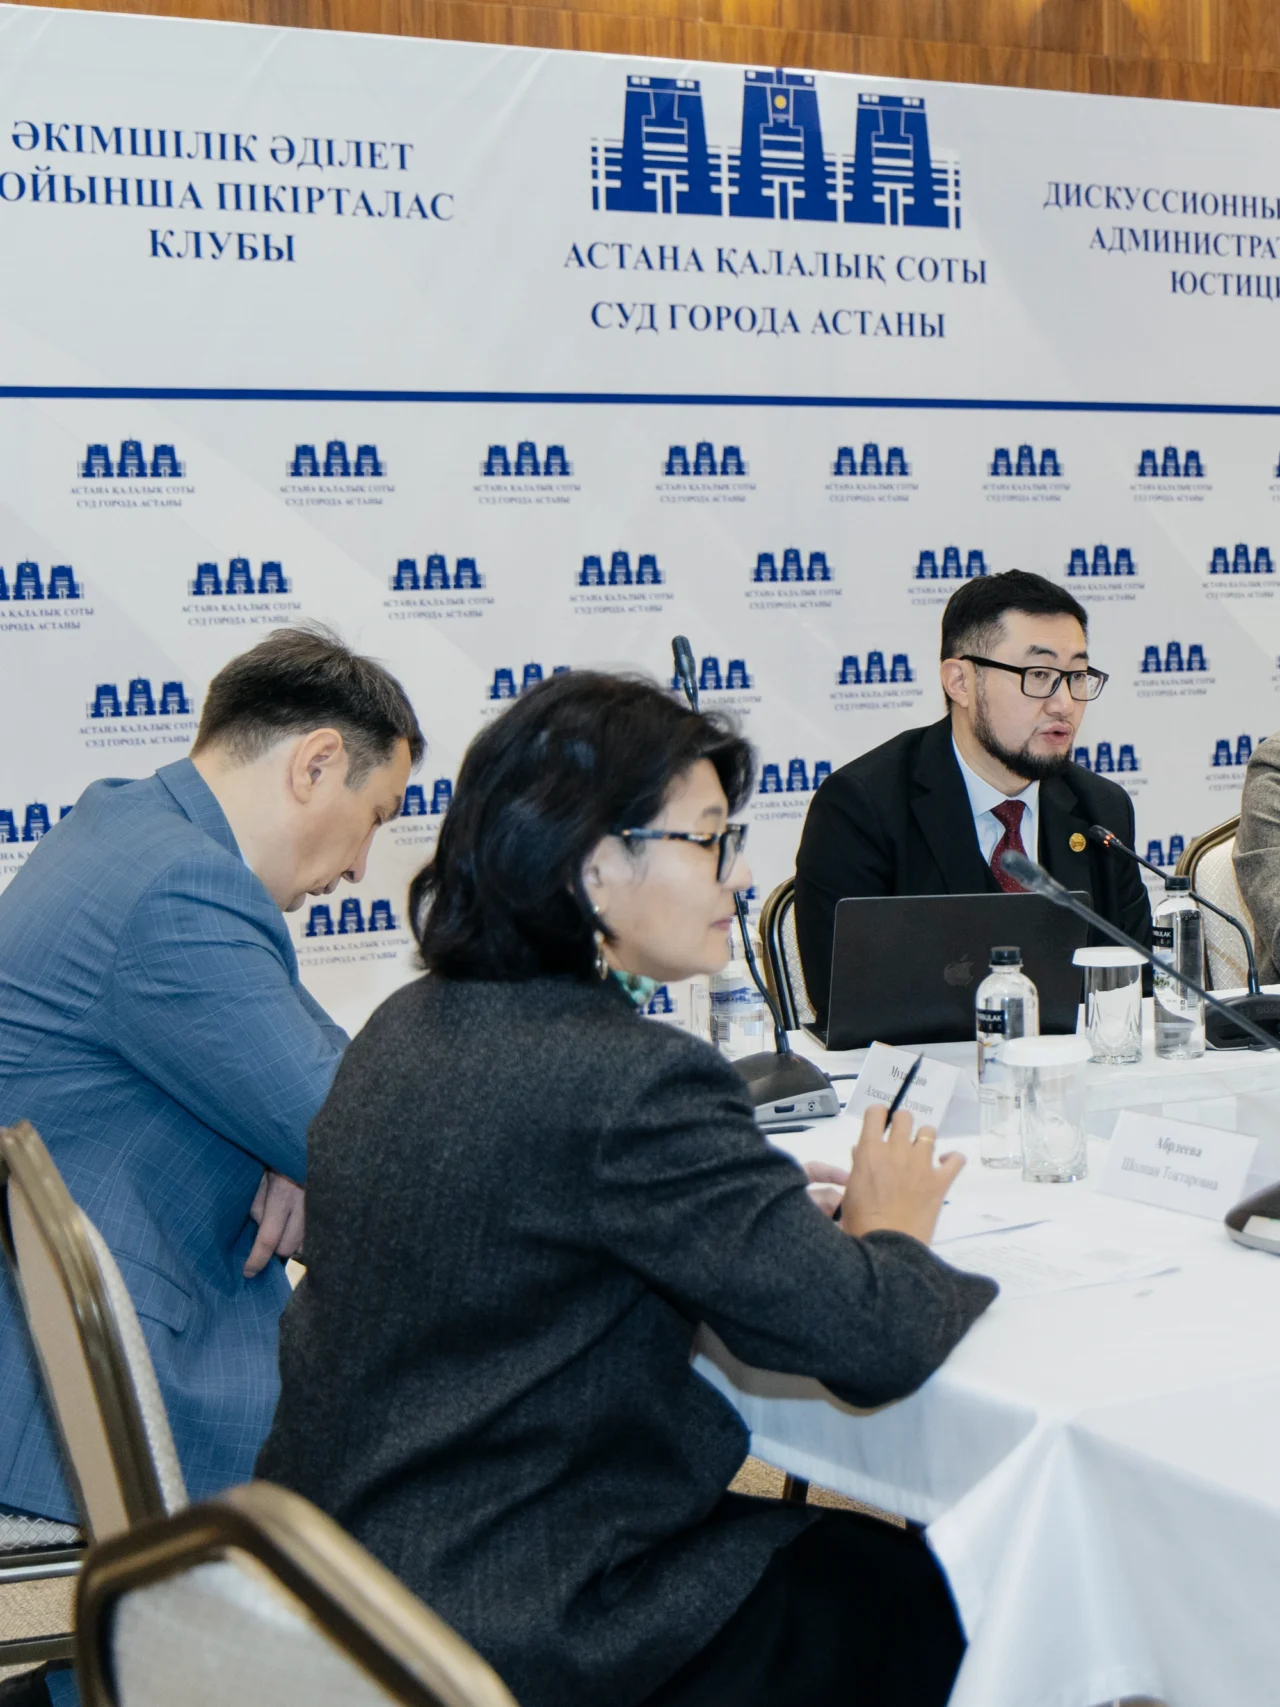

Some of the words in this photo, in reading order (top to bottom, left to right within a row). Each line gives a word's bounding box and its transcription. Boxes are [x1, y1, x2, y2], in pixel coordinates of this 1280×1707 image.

[11, 120, 258, 163] ӘКІМШІЛІК
[269, 135, 414, 171] ӘДІЛЕТ
[217, 183, 454, 221] ПІКІРТАЛАС
[148, 228, 296, 263] КЛУБЫ
[564, 241, 706, 274] АСТАНА
[716, 247, 887, 284] ҚАЛАЛЫҚ
[895, 255, 987, 285] СОТЫ
[590, 301, 659, 334] СУД
[668, 303, 802, 338] ГОРОДА
[811, 309, 945, 339] АСТАНЫ
